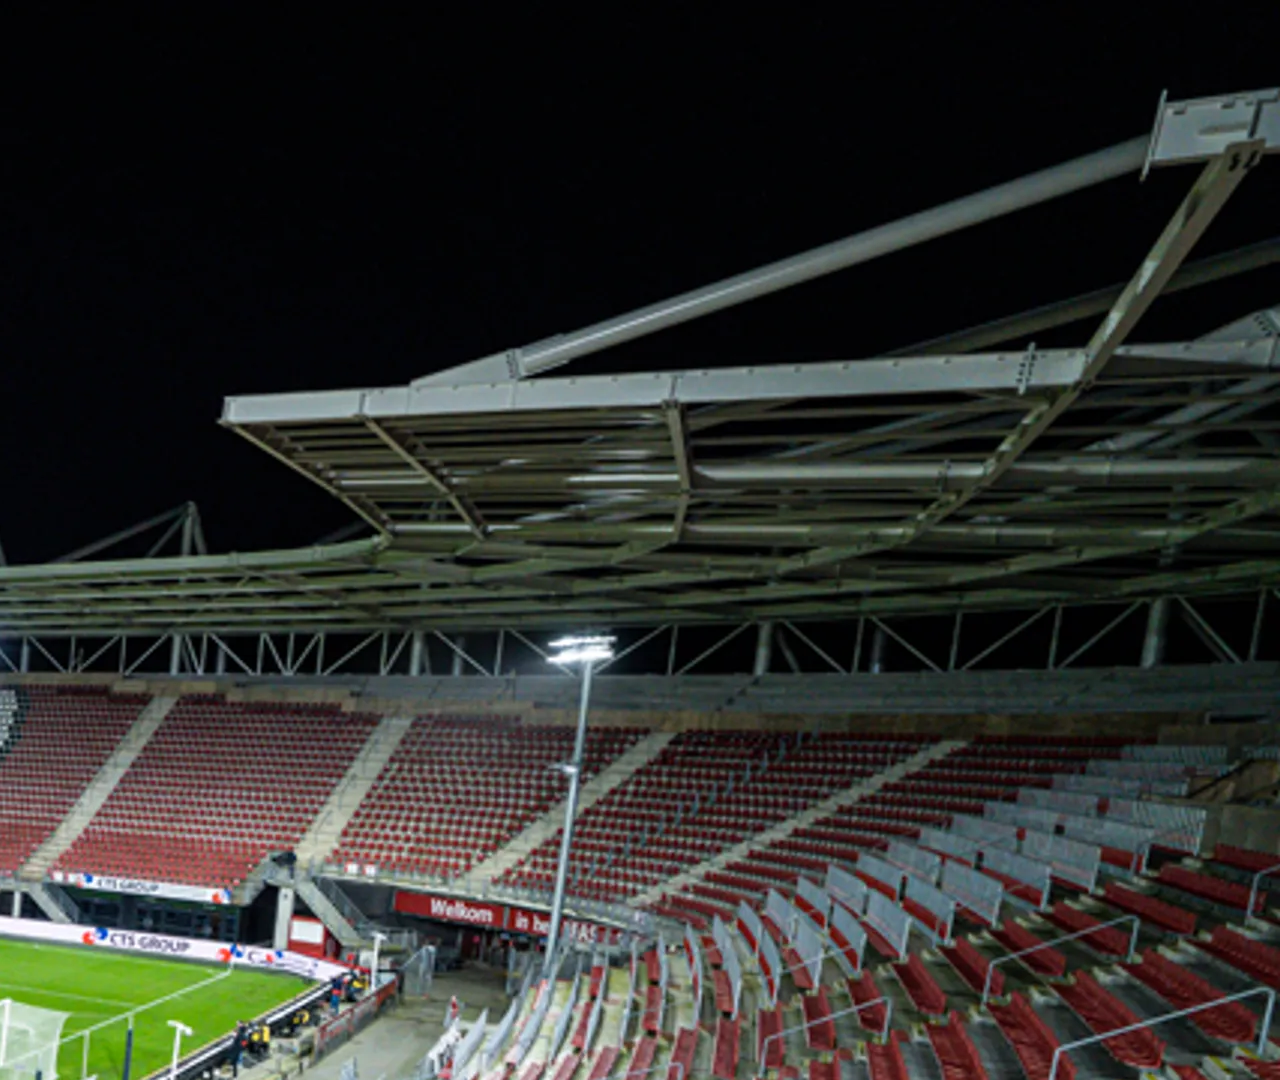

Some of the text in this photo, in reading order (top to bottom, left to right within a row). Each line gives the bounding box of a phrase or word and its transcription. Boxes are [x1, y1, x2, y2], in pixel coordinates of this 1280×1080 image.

[119, 880, 160, 893] GROUP
[429, 897, 493, 923] Welkom
[515, 909, 530, 930] in
[109, 932, 192, 953] CTS GROUP
